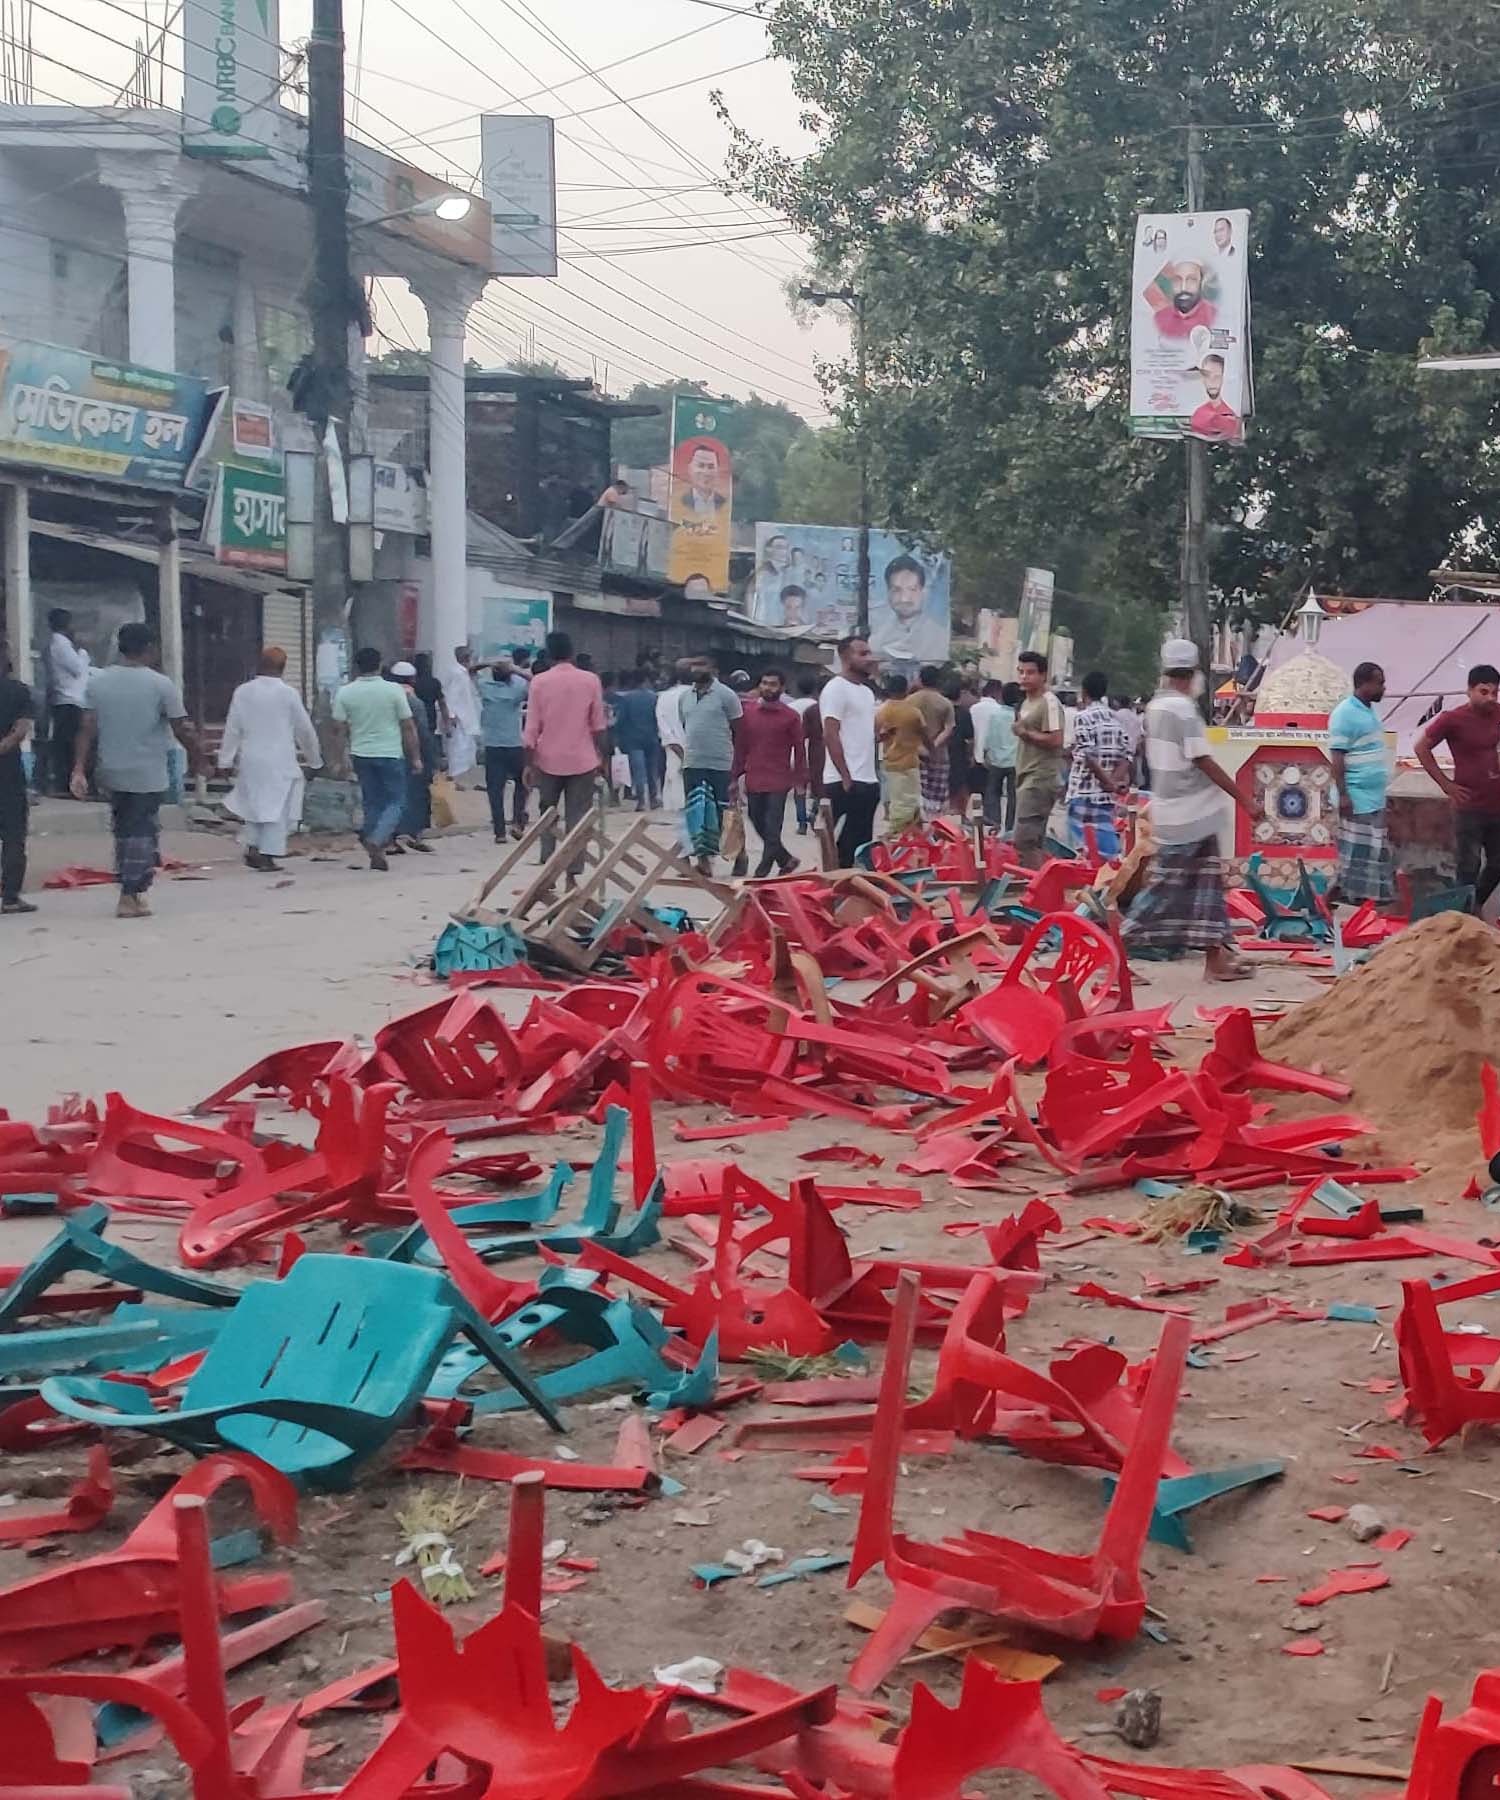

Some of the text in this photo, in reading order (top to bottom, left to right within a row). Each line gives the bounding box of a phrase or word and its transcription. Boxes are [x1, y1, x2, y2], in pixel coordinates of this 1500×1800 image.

[215, 0, 237, 102] NRBC BAN
[12, 374, 140, 443] মেডিকেল
[142, 410, 189, 452] হল
